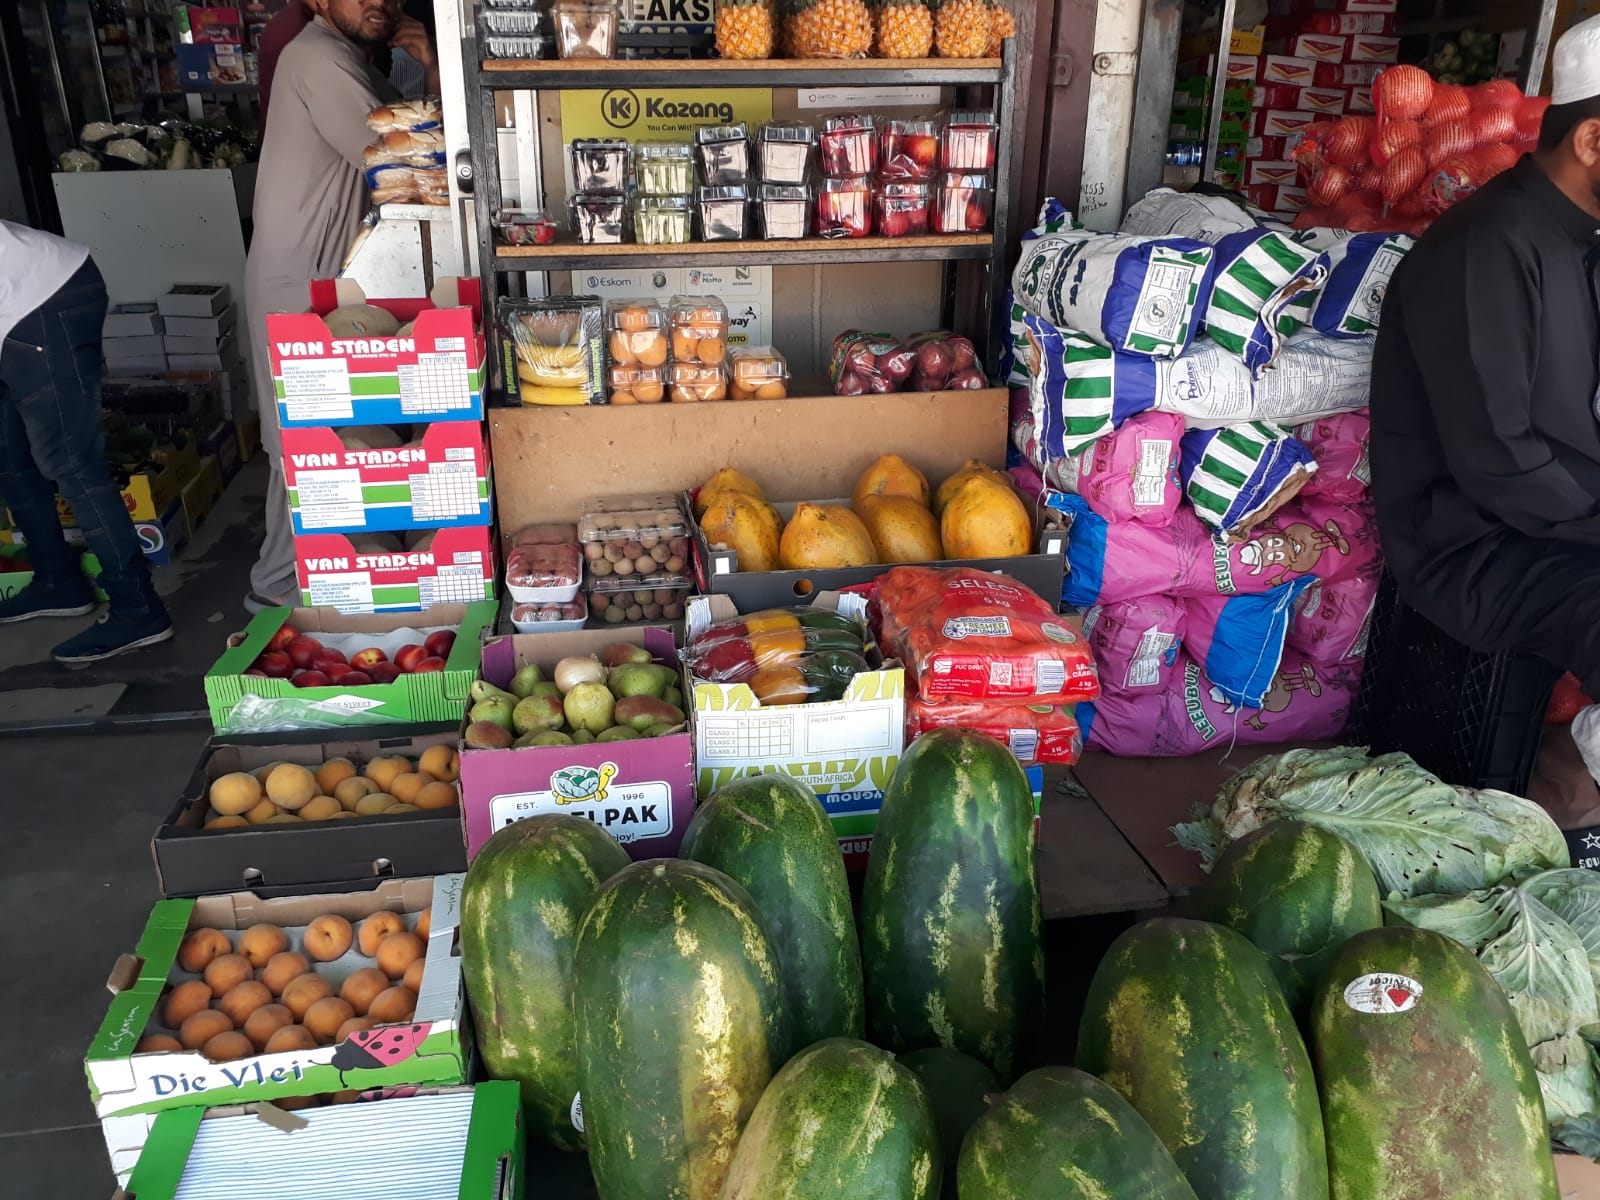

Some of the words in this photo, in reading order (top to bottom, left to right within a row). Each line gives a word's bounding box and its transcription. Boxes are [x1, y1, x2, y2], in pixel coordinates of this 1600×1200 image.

[646, 98, 733, 123] Kazang
[600, 276, 632, 287] Eskom
[276, 342, 324, 356] VAN
[331, 338, 416, 355] STADEN
[290, 453, 338, 468] VAN
[344, 449, 427, 465] STADEN
[304, 557, 349, 571] VAN
[356, 553, 435, 569] STADEN
[948, 579, 1022, 596] SELECT
[995, 599, 1011, 608] kg
[963, 622, 1006, 630] FRESHER
[825, 773, 853, 783] AFRICA
[516, 802, 539, 811] EST.
[622, 792, 645, 801] 1996
[148, 1073, 207, 1095] Die
[219, 1060, 303, 1088] Vlei
